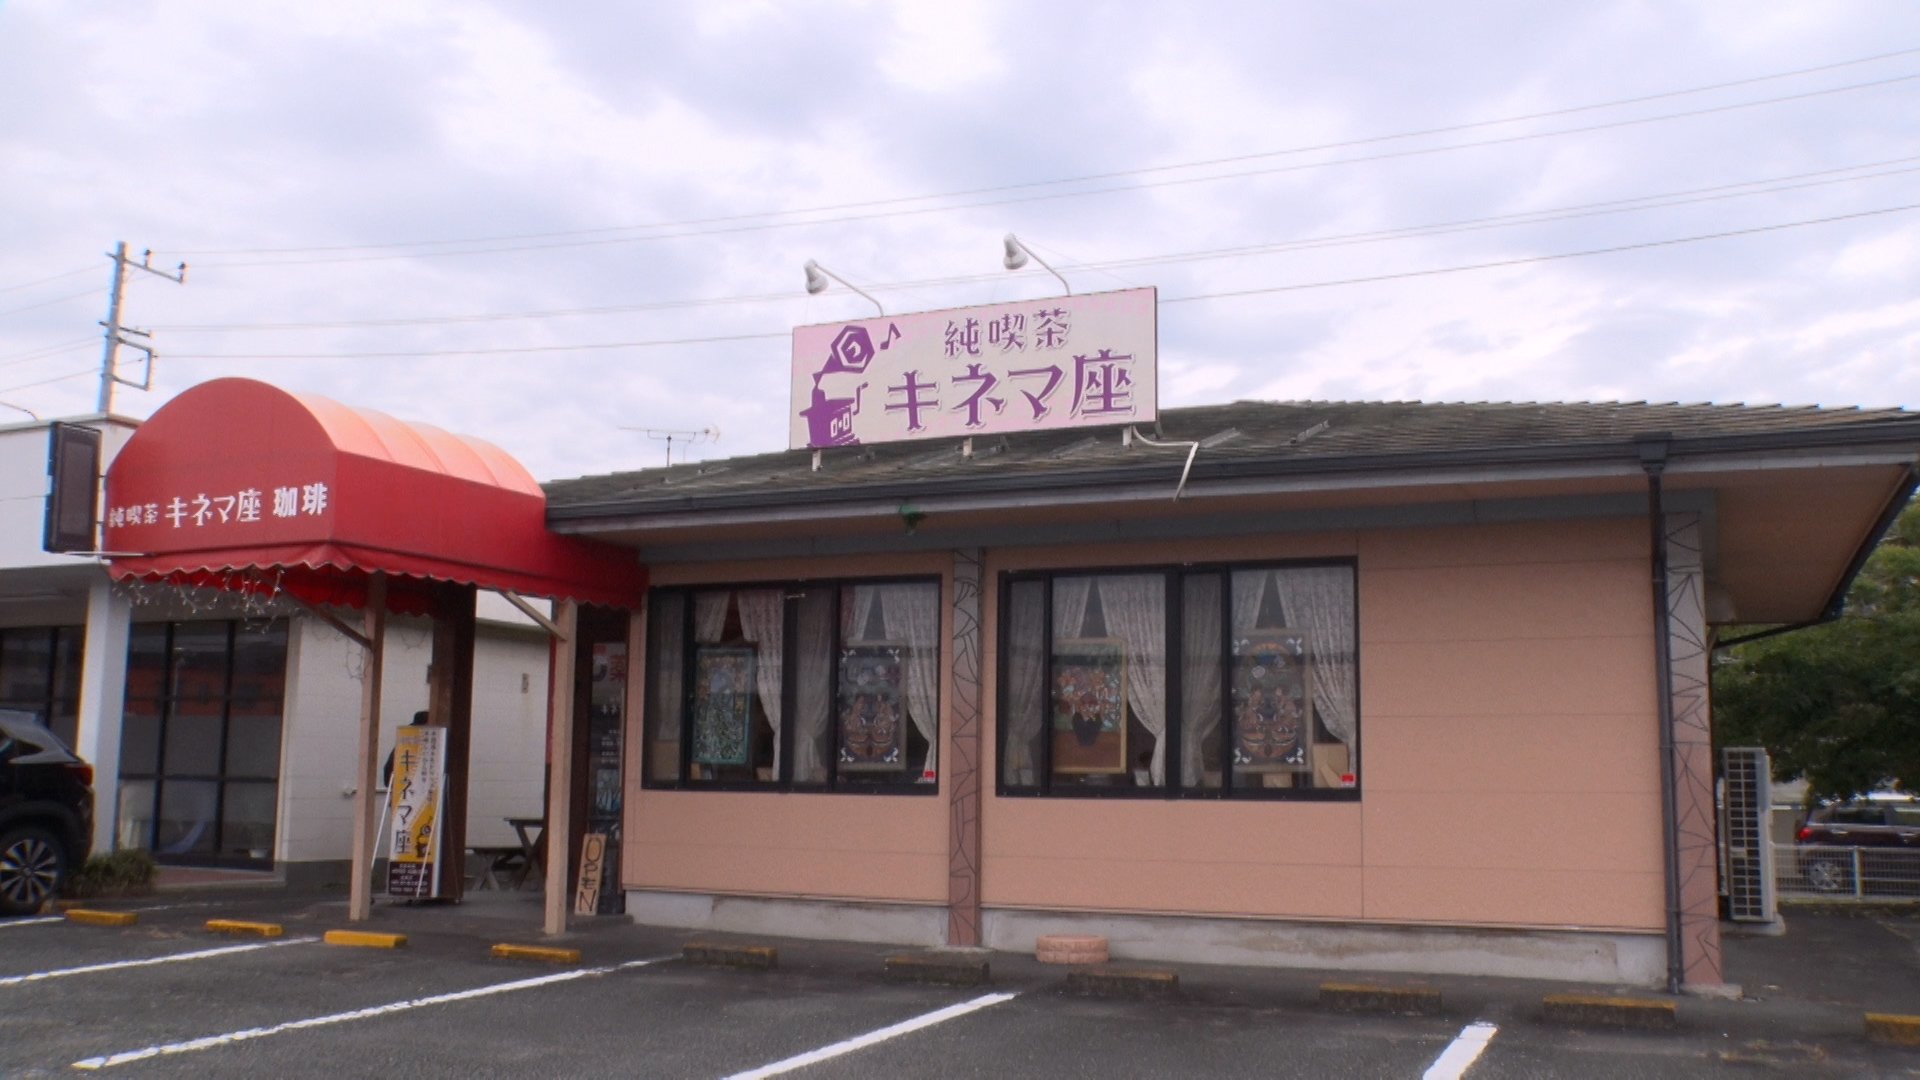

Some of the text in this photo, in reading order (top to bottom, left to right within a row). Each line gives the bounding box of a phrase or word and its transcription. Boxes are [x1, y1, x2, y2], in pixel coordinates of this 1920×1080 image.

[944, 307, 1072, 358] 純喫茶
[883, 348, 1137, 433] キネマ座
[108, 482, 329, 529] 純喫茶 キネマ座 珈琲
[394, 749, 417, 855] キネマ座
[578, 837, 604, 913] OPEN
